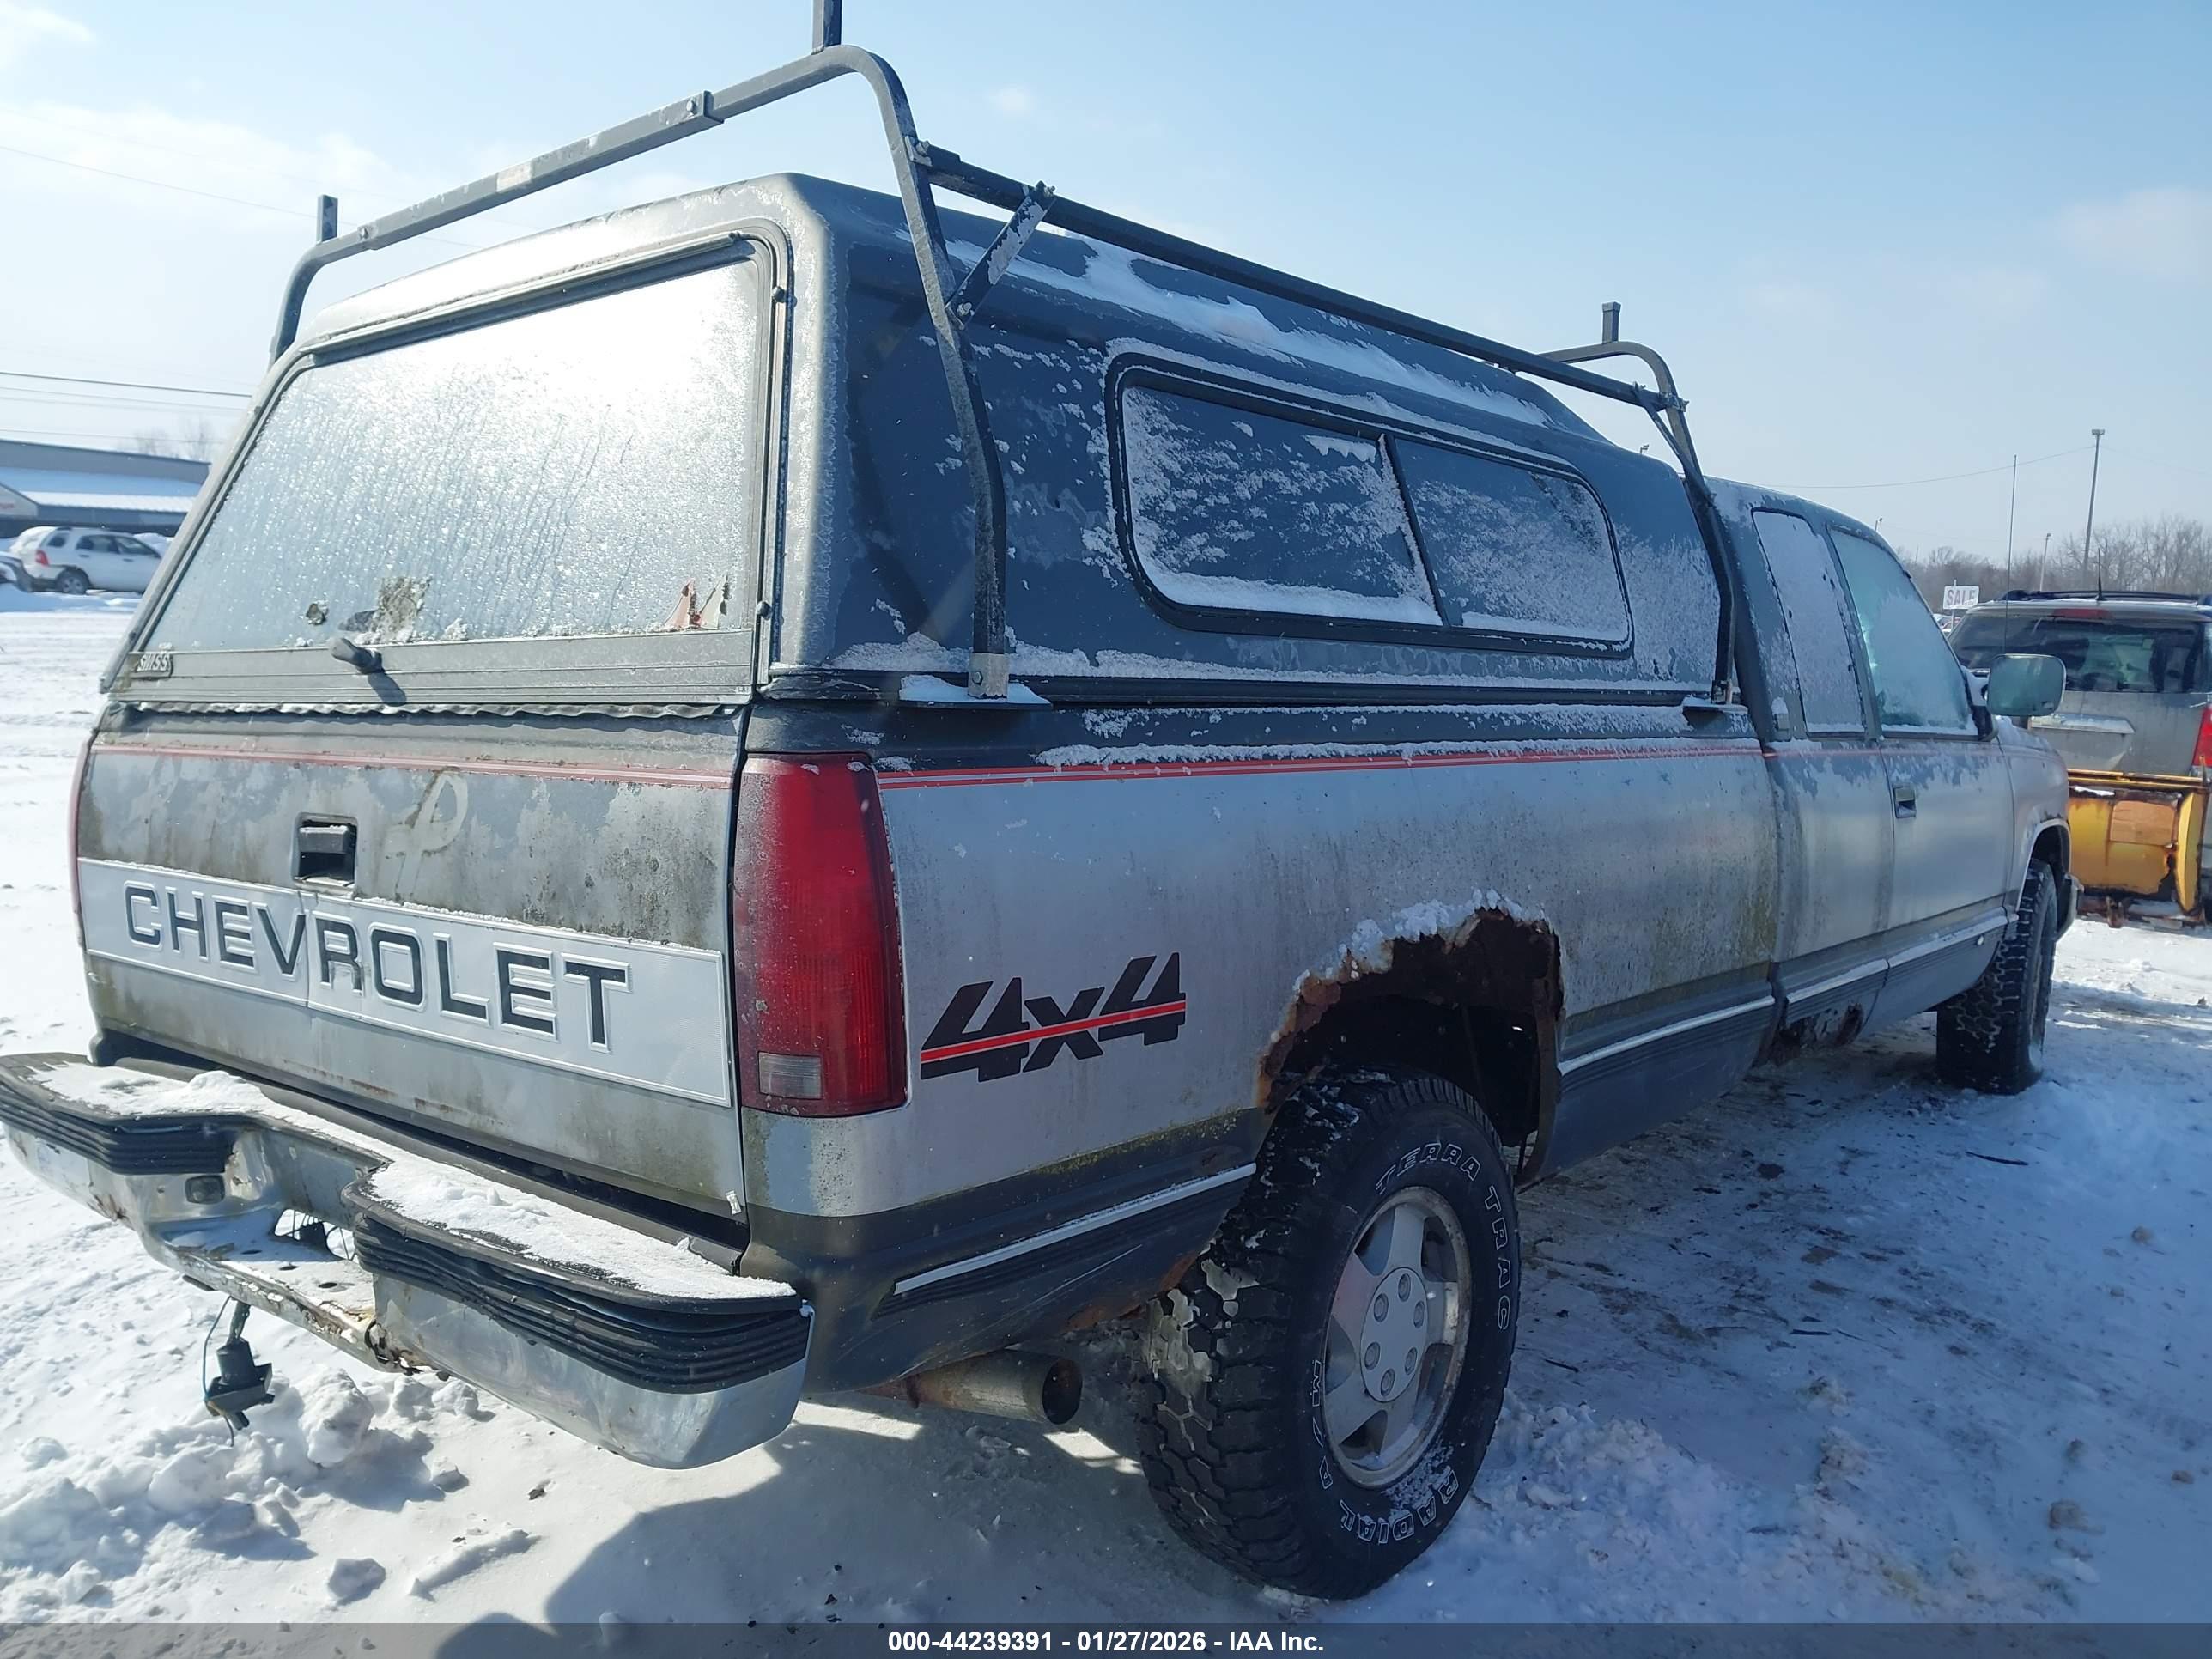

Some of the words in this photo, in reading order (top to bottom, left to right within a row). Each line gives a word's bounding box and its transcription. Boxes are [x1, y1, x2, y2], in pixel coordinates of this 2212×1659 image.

[1947, 589, 1977, 606] SALE
[125, 881, 631, 1052] CHEVROLET
[1376, 1142, 1481, 1195] TERRA
[1485, 1185, 1511, 1330] TRAC
[1339, 1469, 1460, 1545] RADIAL
